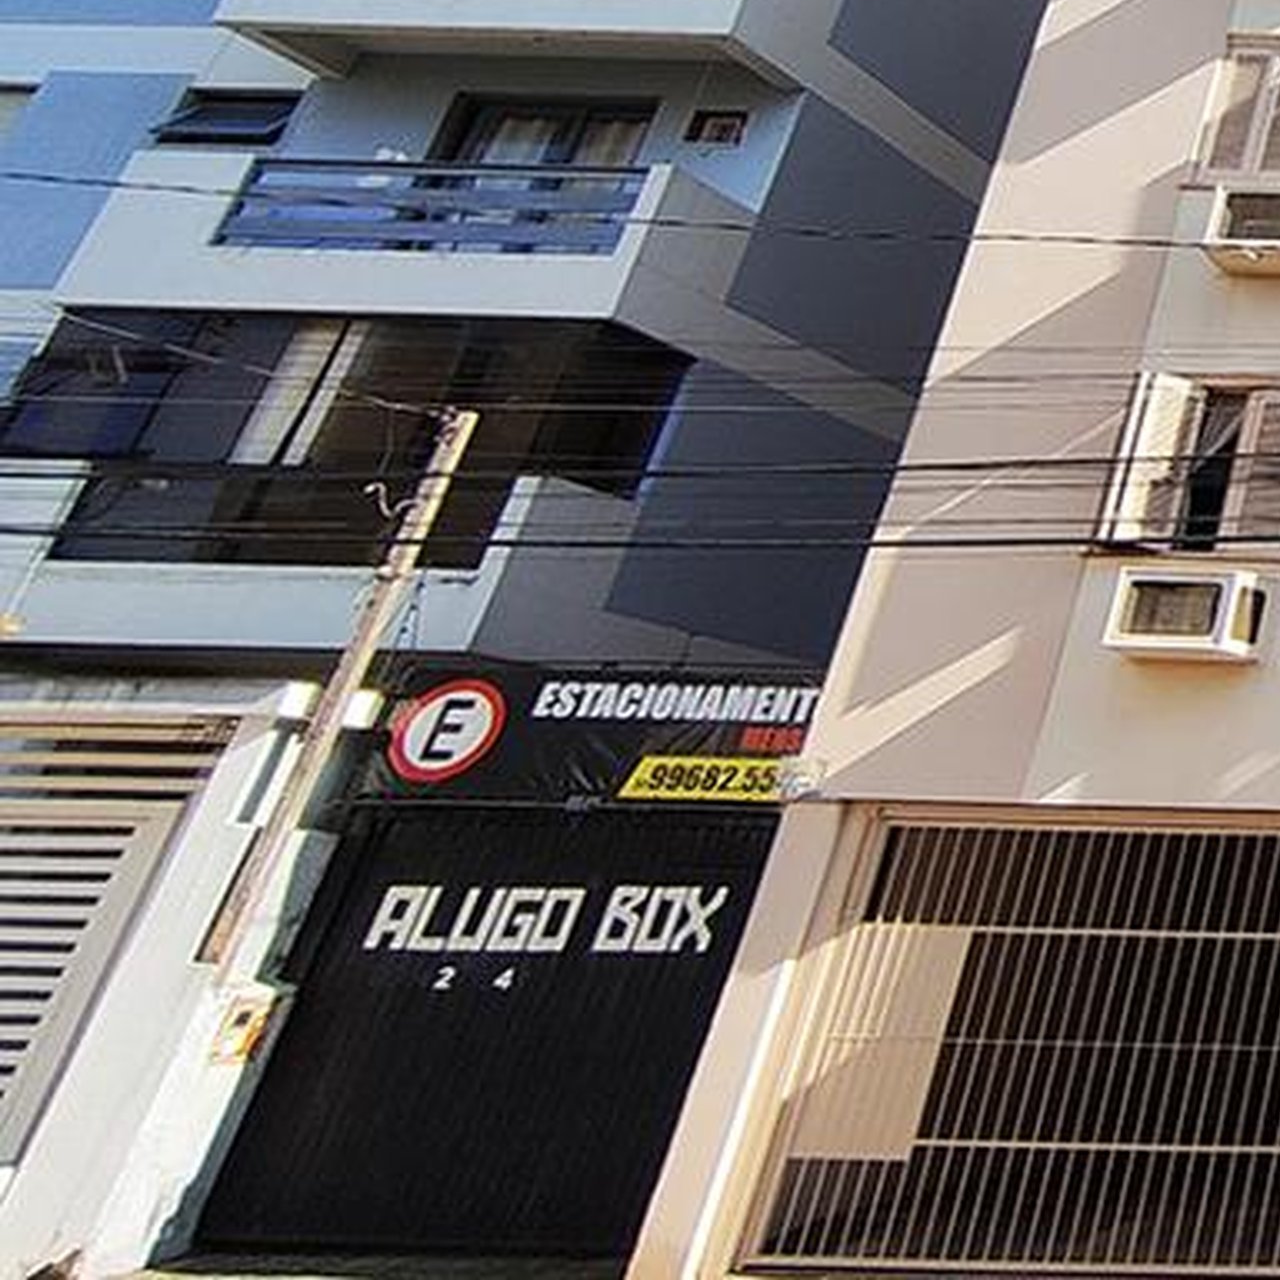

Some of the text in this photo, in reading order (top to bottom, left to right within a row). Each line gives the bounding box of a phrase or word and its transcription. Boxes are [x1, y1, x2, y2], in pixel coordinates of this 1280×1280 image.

[532, 682, 819, 721] ESTACIONAMENT
[419, 699, 476, 761] E
[363, 885, 728, 952] ALUGO BOX
[432, 967, 515, 990] 2 4
